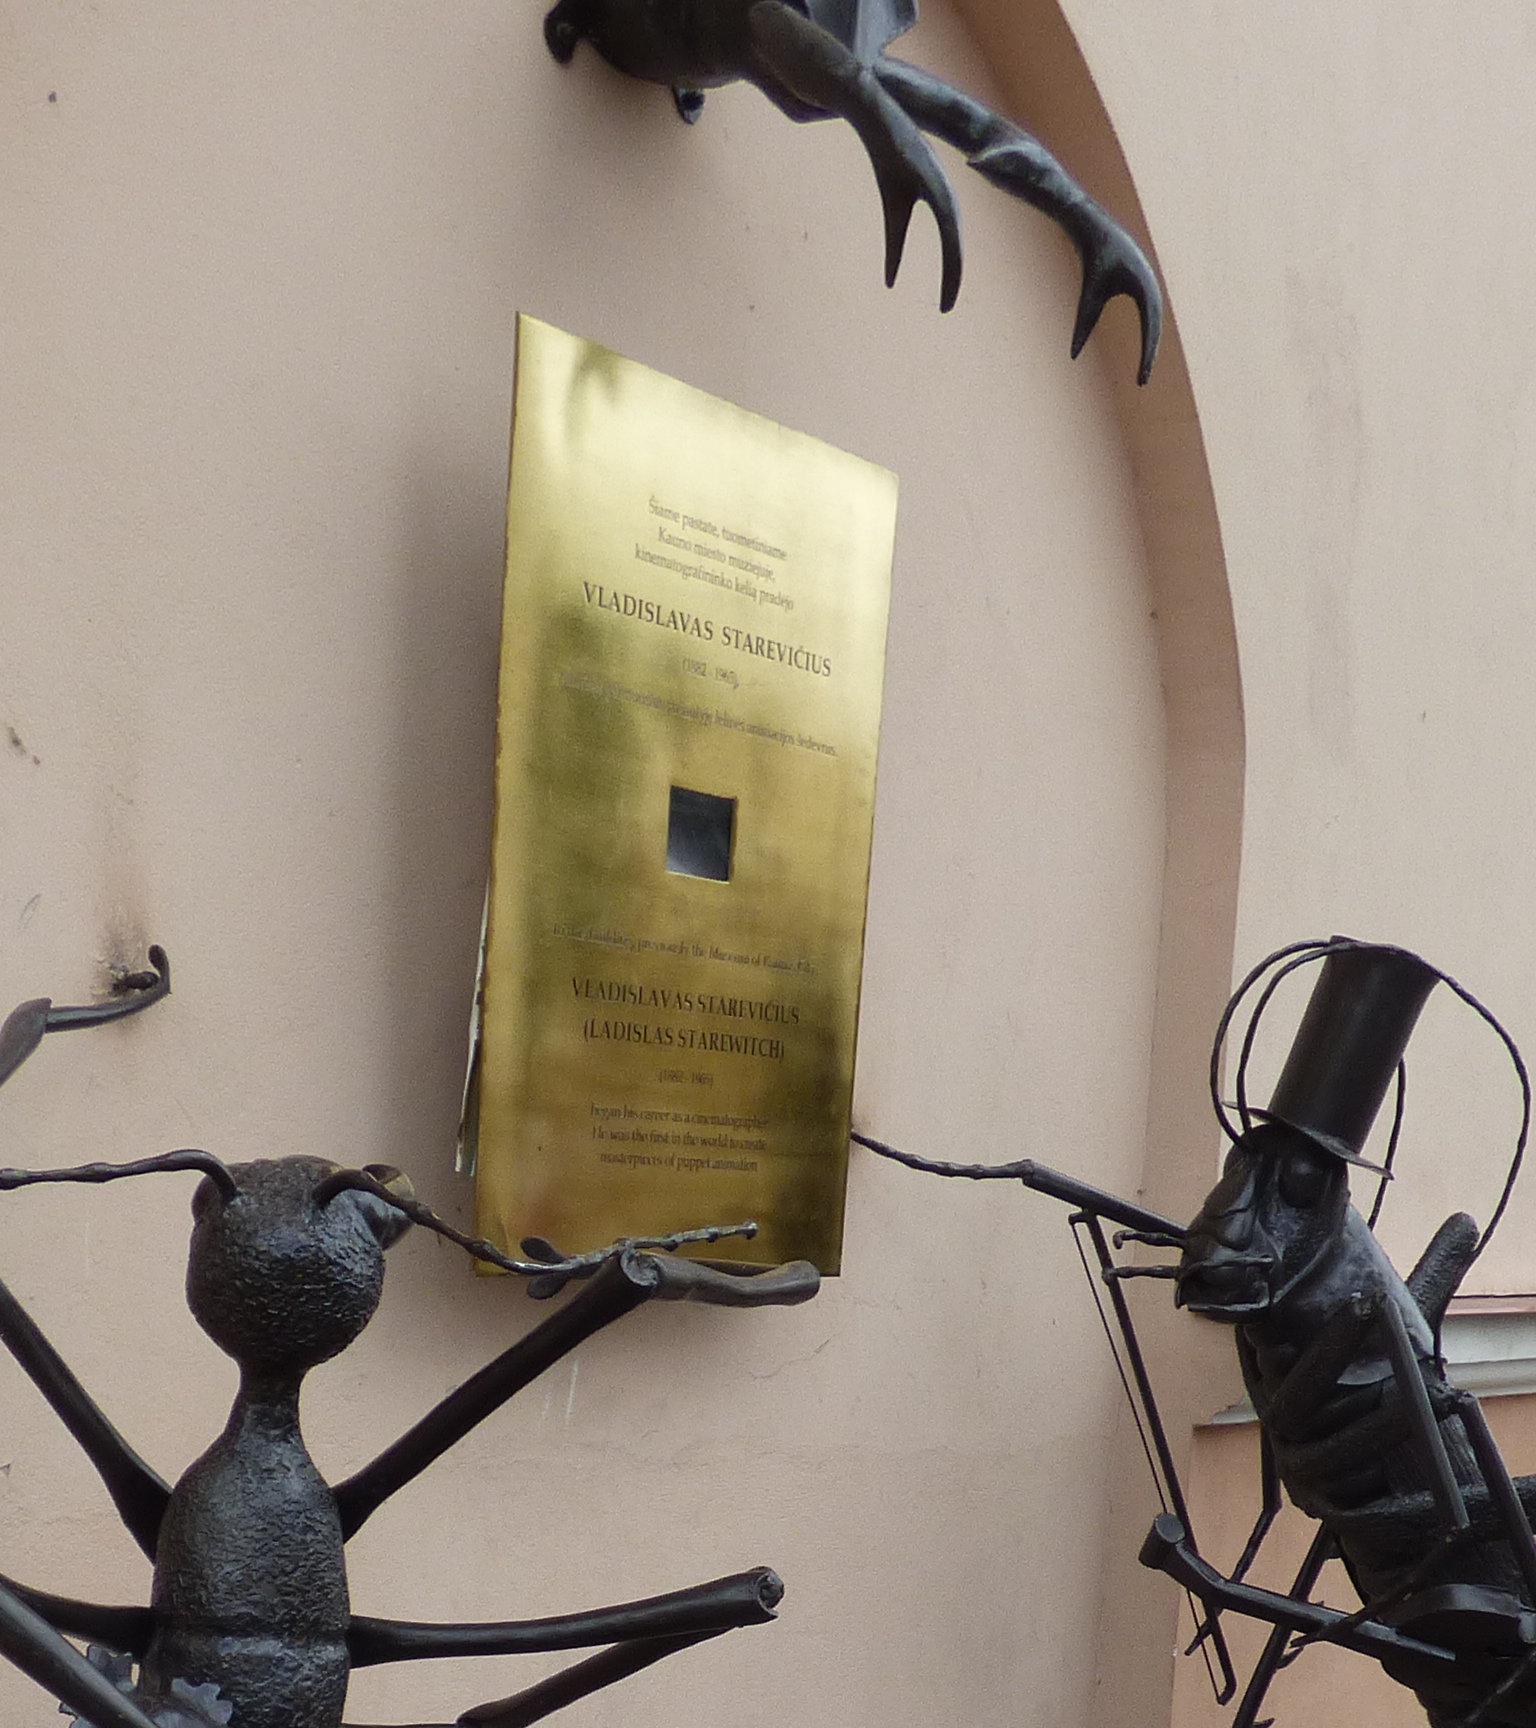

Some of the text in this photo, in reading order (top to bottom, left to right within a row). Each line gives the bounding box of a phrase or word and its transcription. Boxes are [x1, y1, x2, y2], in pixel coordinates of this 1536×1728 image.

[658, 526, 692, 551] Kauno
[693, 541, 727, 563] miesto
[583, 580, 832, 678] VLADISLAVAS STAREVIČIUS
[572, 977, 694, 1012] VLADISLAVAS
[583, 1018, 786, 1062] (LADISLAS STAREWITCH)
[671, 1112, 683, 1122] as
[684, 1113, 690, 1123] a
[610, 1130, 630, 1142] was
[631, 1128, 648, 1142] the
[649, 1129, 670, 1143] first
[682, 1131, 699, 1146] the
[664, 1153, 675, 1166] of
[676, 1156, 710, 1172] puppet
